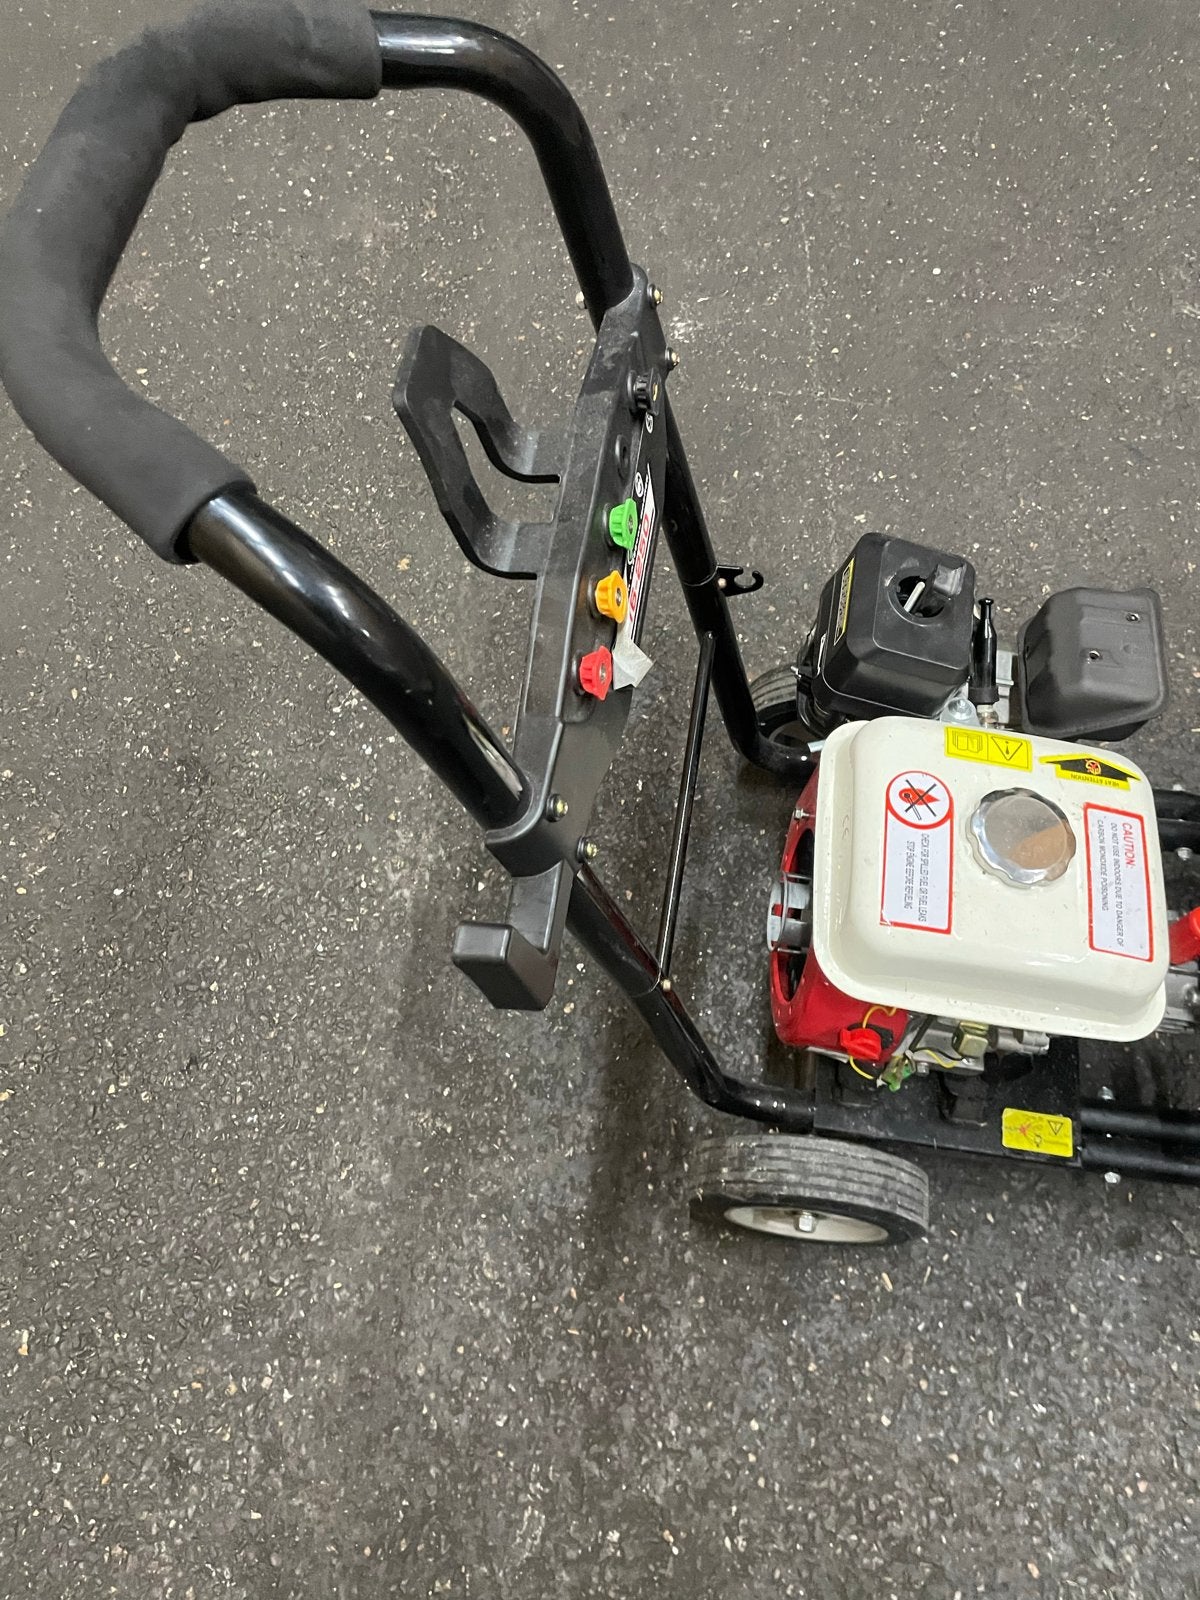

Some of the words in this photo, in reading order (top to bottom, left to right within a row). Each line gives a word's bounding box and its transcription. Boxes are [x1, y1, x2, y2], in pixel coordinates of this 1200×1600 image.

[1070, 773, 1104, 784] ATTENTION
[1097, 819, 1105, 844] CARBON
[1110, 822, 1118, 831] DO
[1112, 845, 1120, 857] USE
[1099, 845, 1108, 876] MONOXIDE
[1113, 858, 1121, 885] INDOORS
[1101, 877, 1109, 911] POISONING
[1116, 900, 1123, 909] TO
[1116, 910, 1124, 936] DANGER
[1117, 937, 1125, 947] OF
